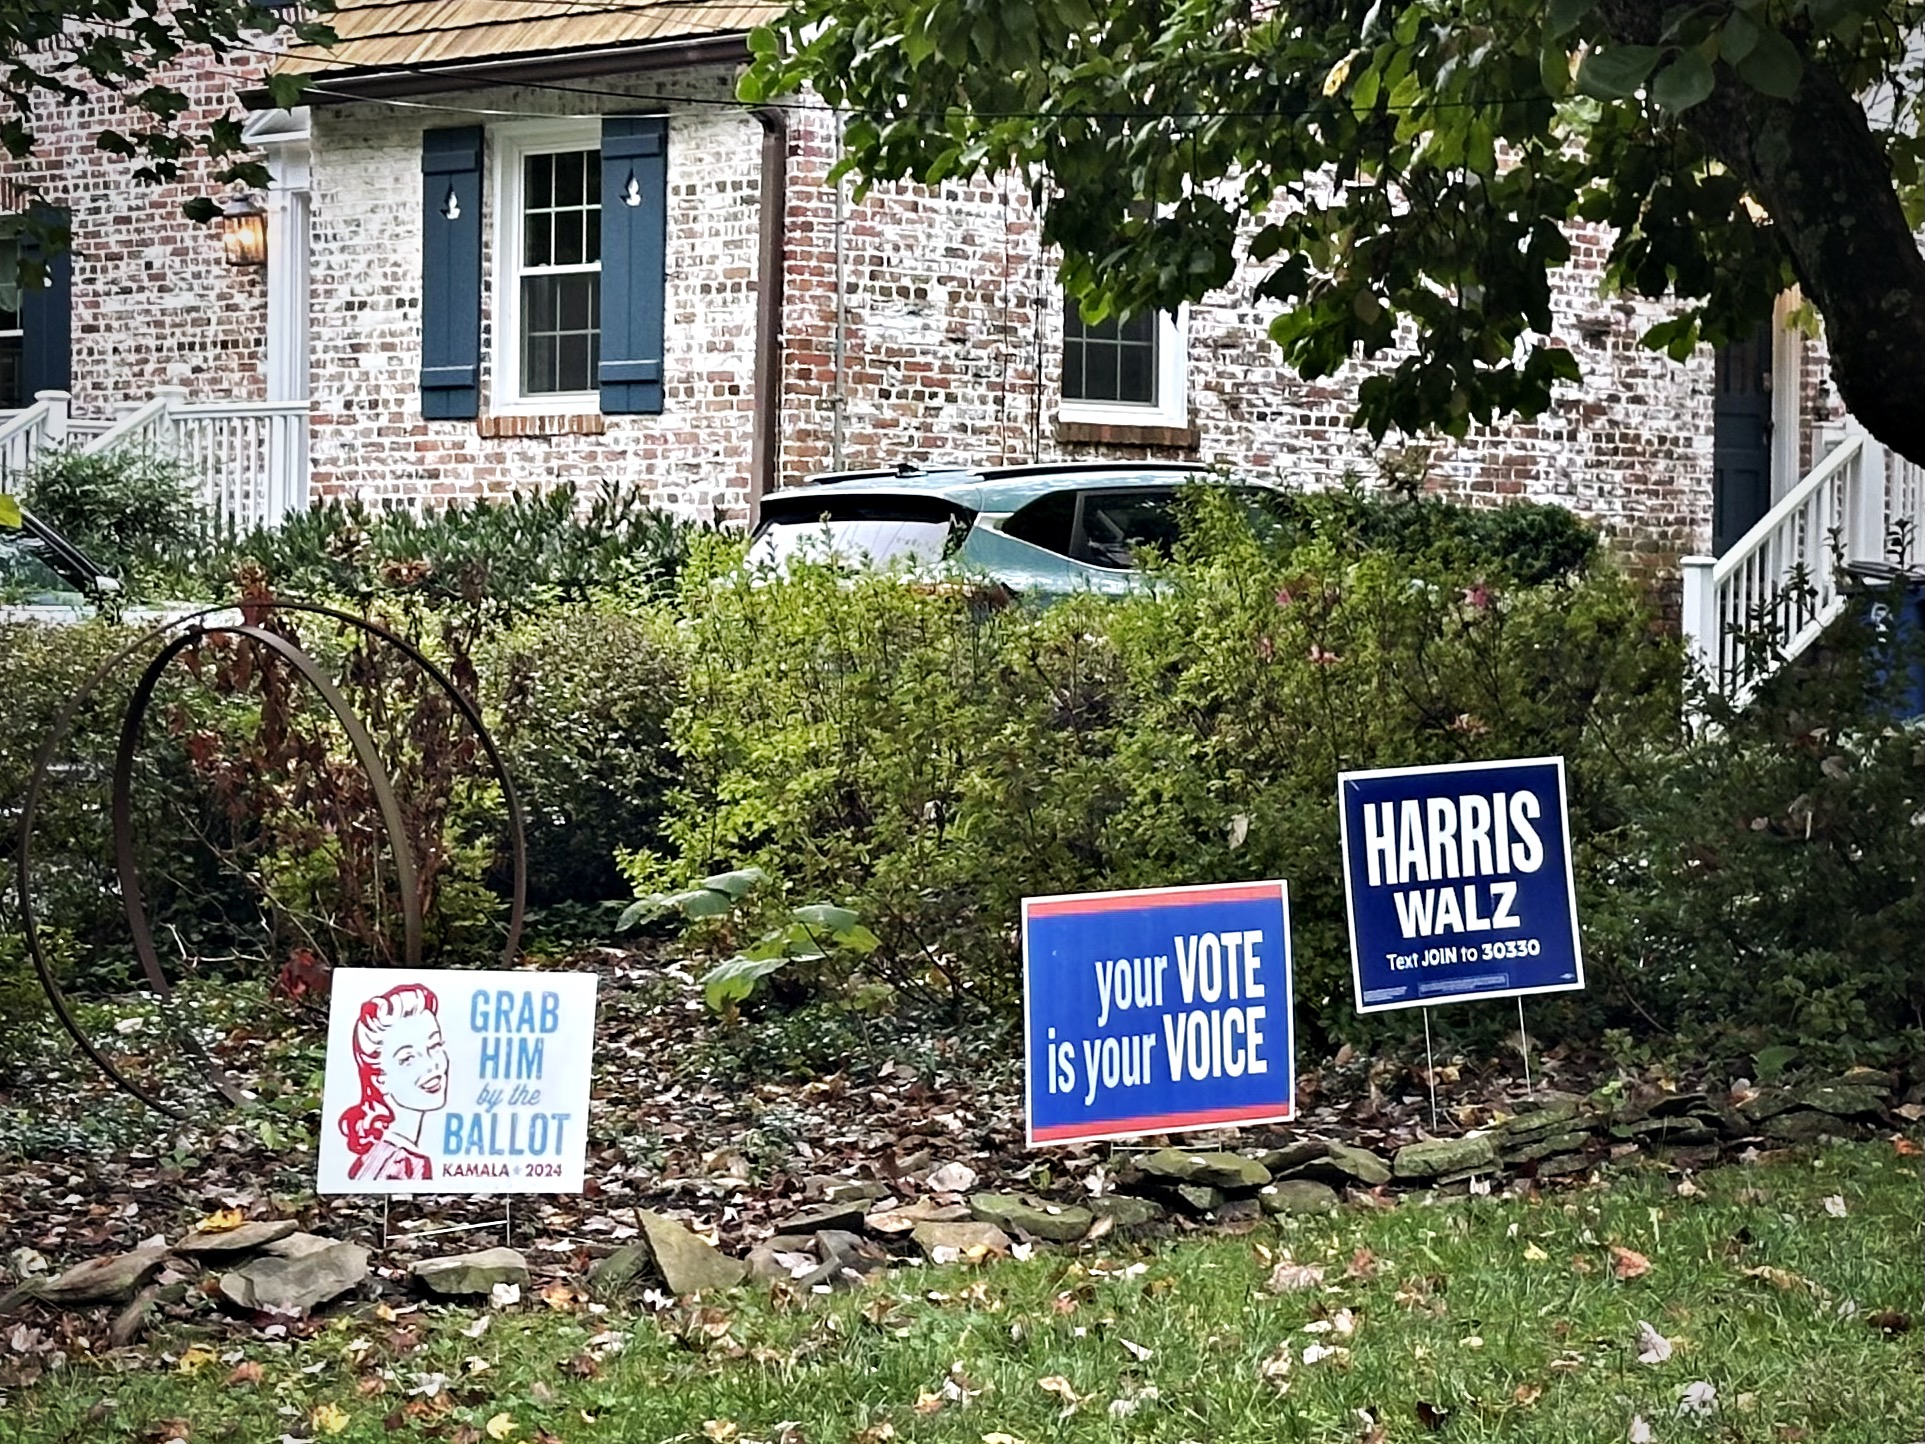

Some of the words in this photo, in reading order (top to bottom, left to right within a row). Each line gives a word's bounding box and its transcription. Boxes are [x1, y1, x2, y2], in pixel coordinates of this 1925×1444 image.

[1363, 790, 1544, 886] HARRIS
[1393, 881, 1521, 938] WALZ
[1386, 953, 1419, 970] Text
[1421, 946, 1457, 967] JOIN
[1461, 945, 1477, 962] to
[1481, 939, 1540, 960] 30330
[1095, 955, 1168, 1027] your
[1174, 930, 1265, 1004] VOTE
[470, 989, 560, 1034] GRAB
[479, 1037, 544, 1080] HIM
[1048, 1027, 1076, 1094] is
[1083, 1033, 1156, 1106] your
[1162, 1006, 1268, 1082] VOICE
[475, 1083, 503, 1113] by
[507, 1082, 541, 1106] the
[443, 1113, 571, 1156] BALLOT
[442, 1163, 509, 1178] KAMALA
[525, 1163, 562, 1178] 2024
